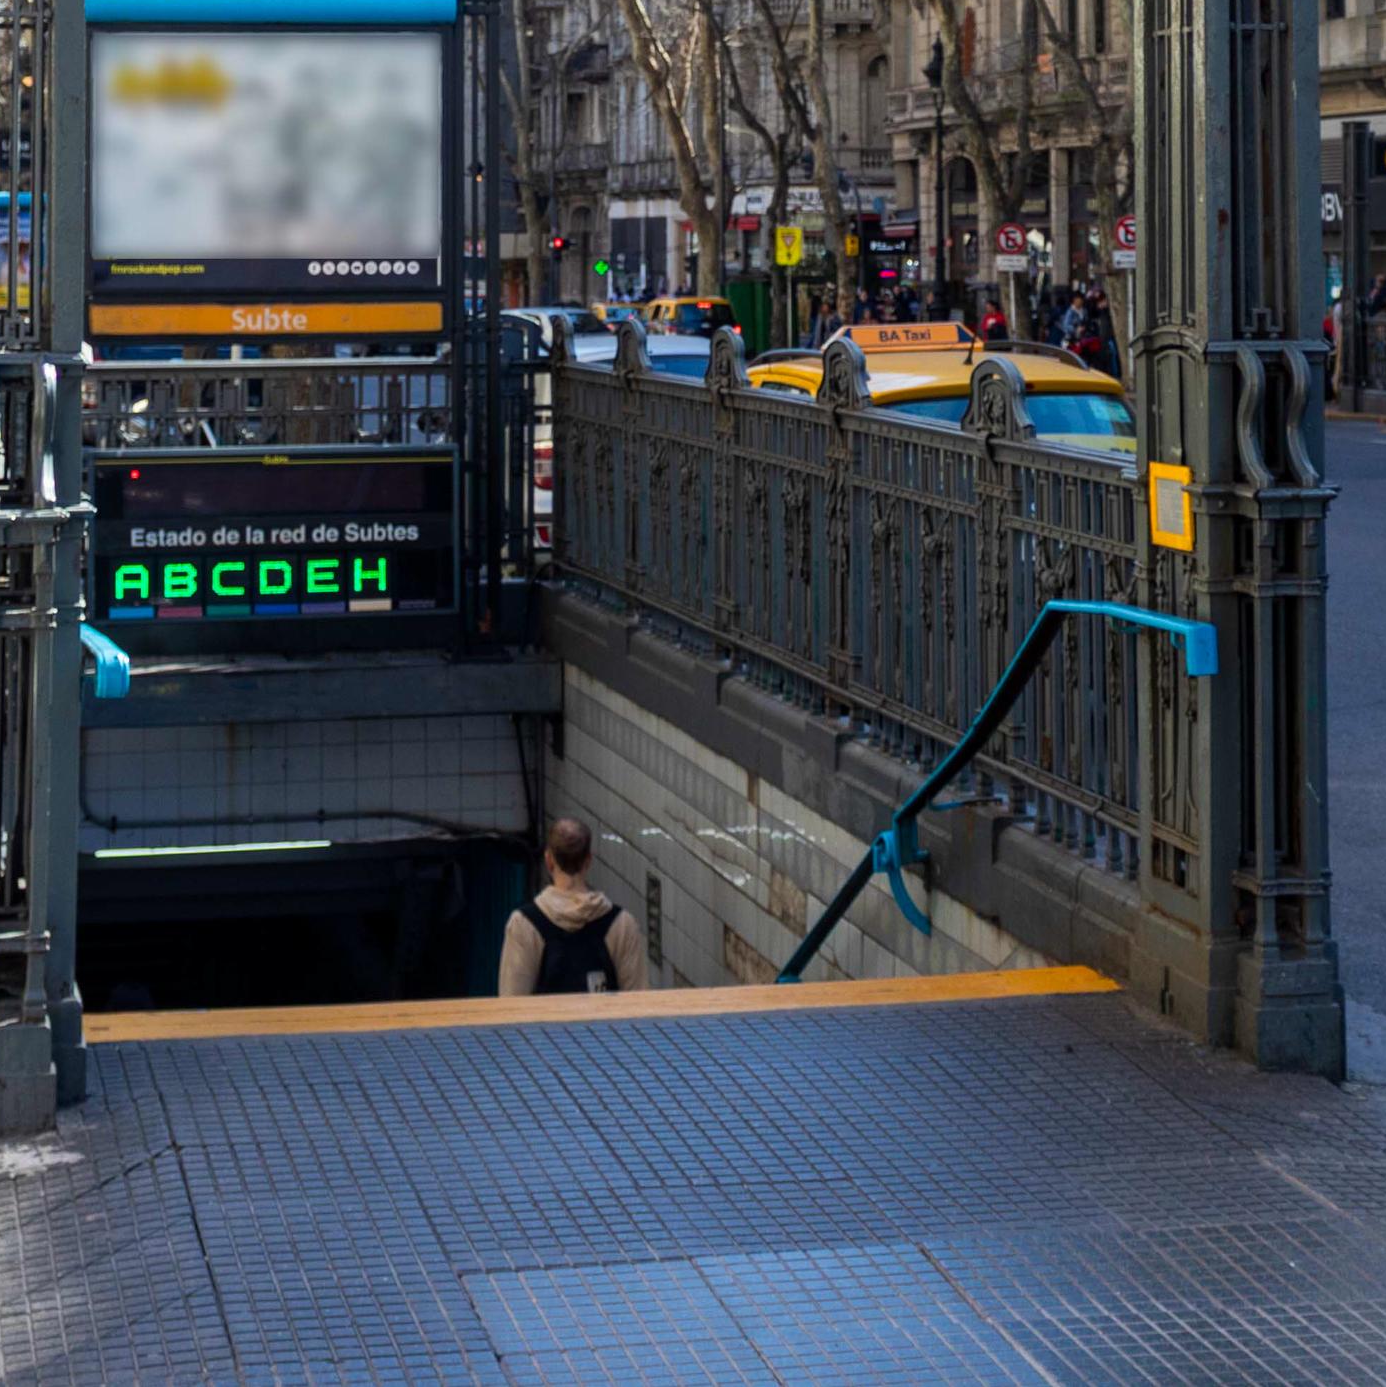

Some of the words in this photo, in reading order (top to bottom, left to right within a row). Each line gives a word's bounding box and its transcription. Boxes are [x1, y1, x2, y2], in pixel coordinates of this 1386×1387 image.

[231, 307, 308, 332] Subte
[878, 329, 900, 343] BA
[902, 328, 931, 342] Taxi
[130, 527, 206, 548] Estado
[213, 526, 239, 547] de
[246, 525, 264, 546] la
[271, 524, 306, 544] red
[313, 523, 339, 543] de
[344, 522, 419, 543] Subtes
